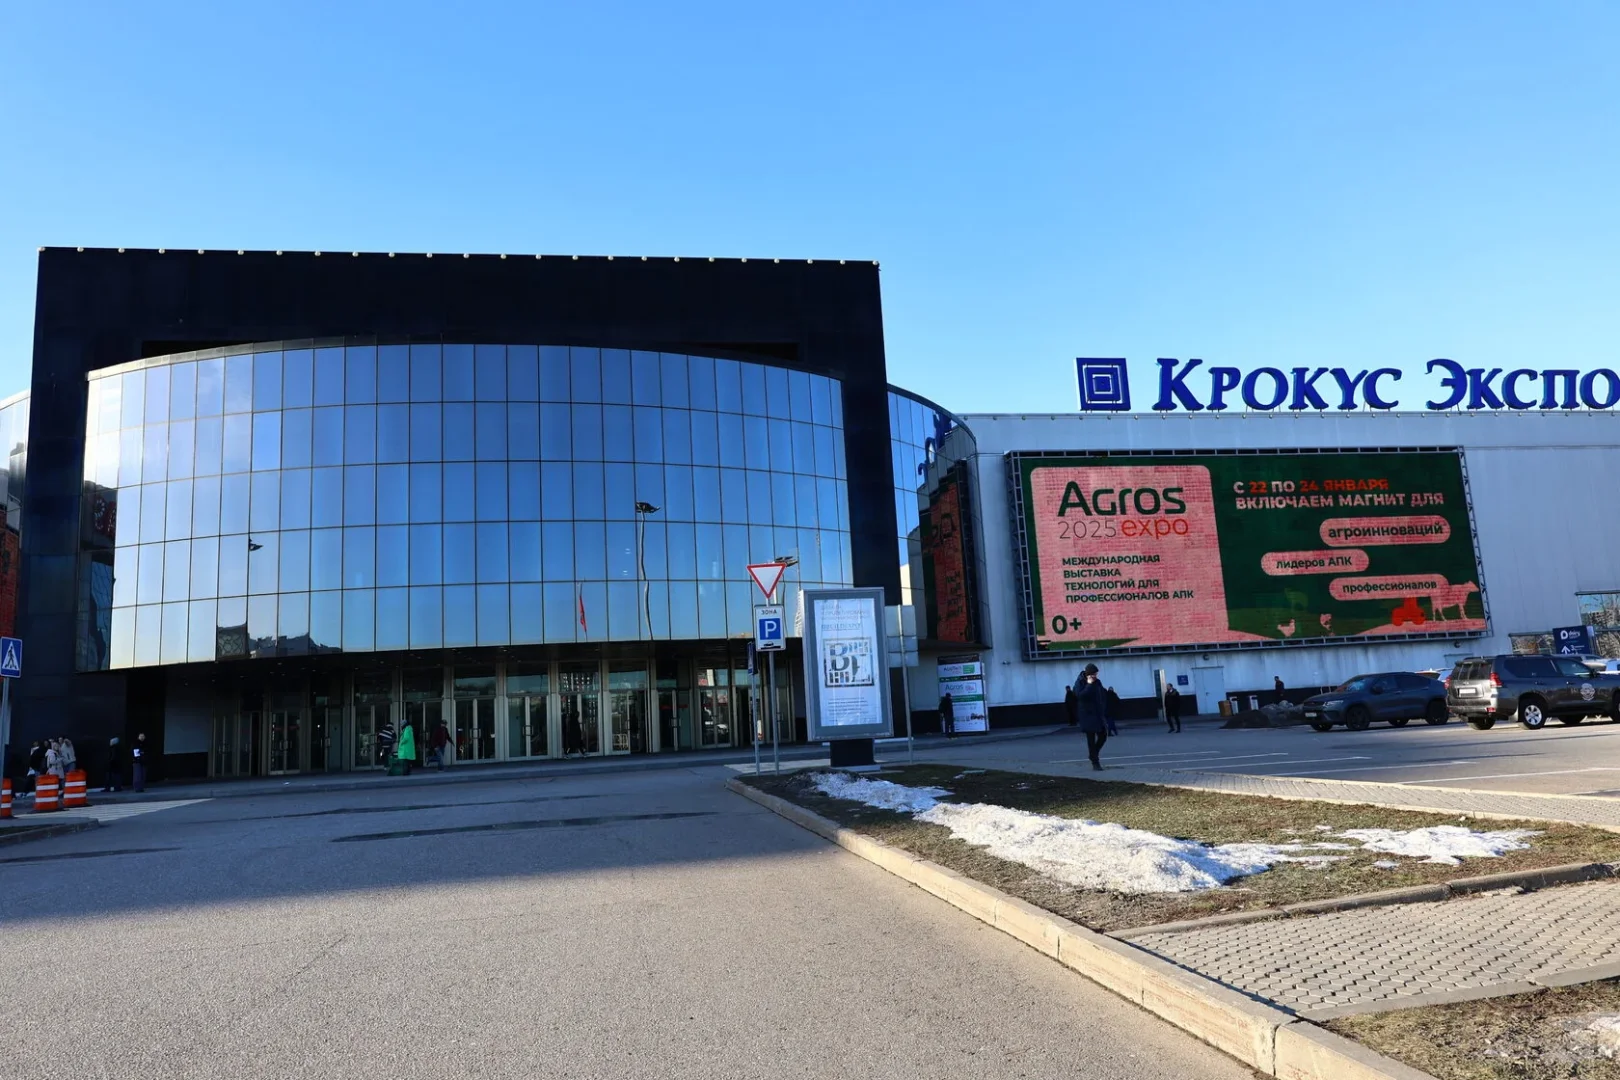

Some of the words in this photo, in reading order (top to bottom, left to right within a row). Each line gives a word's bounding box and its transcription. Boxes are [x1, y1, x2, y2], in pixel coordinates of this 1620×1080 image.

[1152, 357, 1402, 411] КРОКУС
[1425, 358, 1620, 411] ЭКСПО
[1233, 481, 1245, 494] С
[1249, 481, 1267, 493] 22
[1271, 481, 1295, 493] ПО
[1300, 480, 1319, 491] 24
[1323, 479, 1389, 491] ЯНВАРЯ
[1235, 494, 1334, 510] ВКЛЮЧАЕМ
[1339, 493, 1405, 507] МАГНИТ
[1411, 492, 1444, 508] ДЛЯ
[1057, 519, 1117, 540] 2025
[1121, 517, 1189, 540] expo
[1328, 521, 1444, 540] агроинноваций
[1062, 554, 1161, 566] МЕЖДУНАРОДНАЯ
[1276, 558, 1325, 570] лидеров
[1328, 555, 1353, 567] АПК
[1063, 569, 1122, 579] ВЫСТАВКА
[1064, 579, 1135, 591] ТЕХНОЛОГИЙ
[1138, 579, 1160, 589] ДЛЯ
[1342, 580, 1437, 594] профессионалов
[1066, 592, 1170, 604] ПРОФЕССИОНАЛОВ
[1172, 590, 1194, 600] АПК
[1052, 614, 1082, 634] 0+
